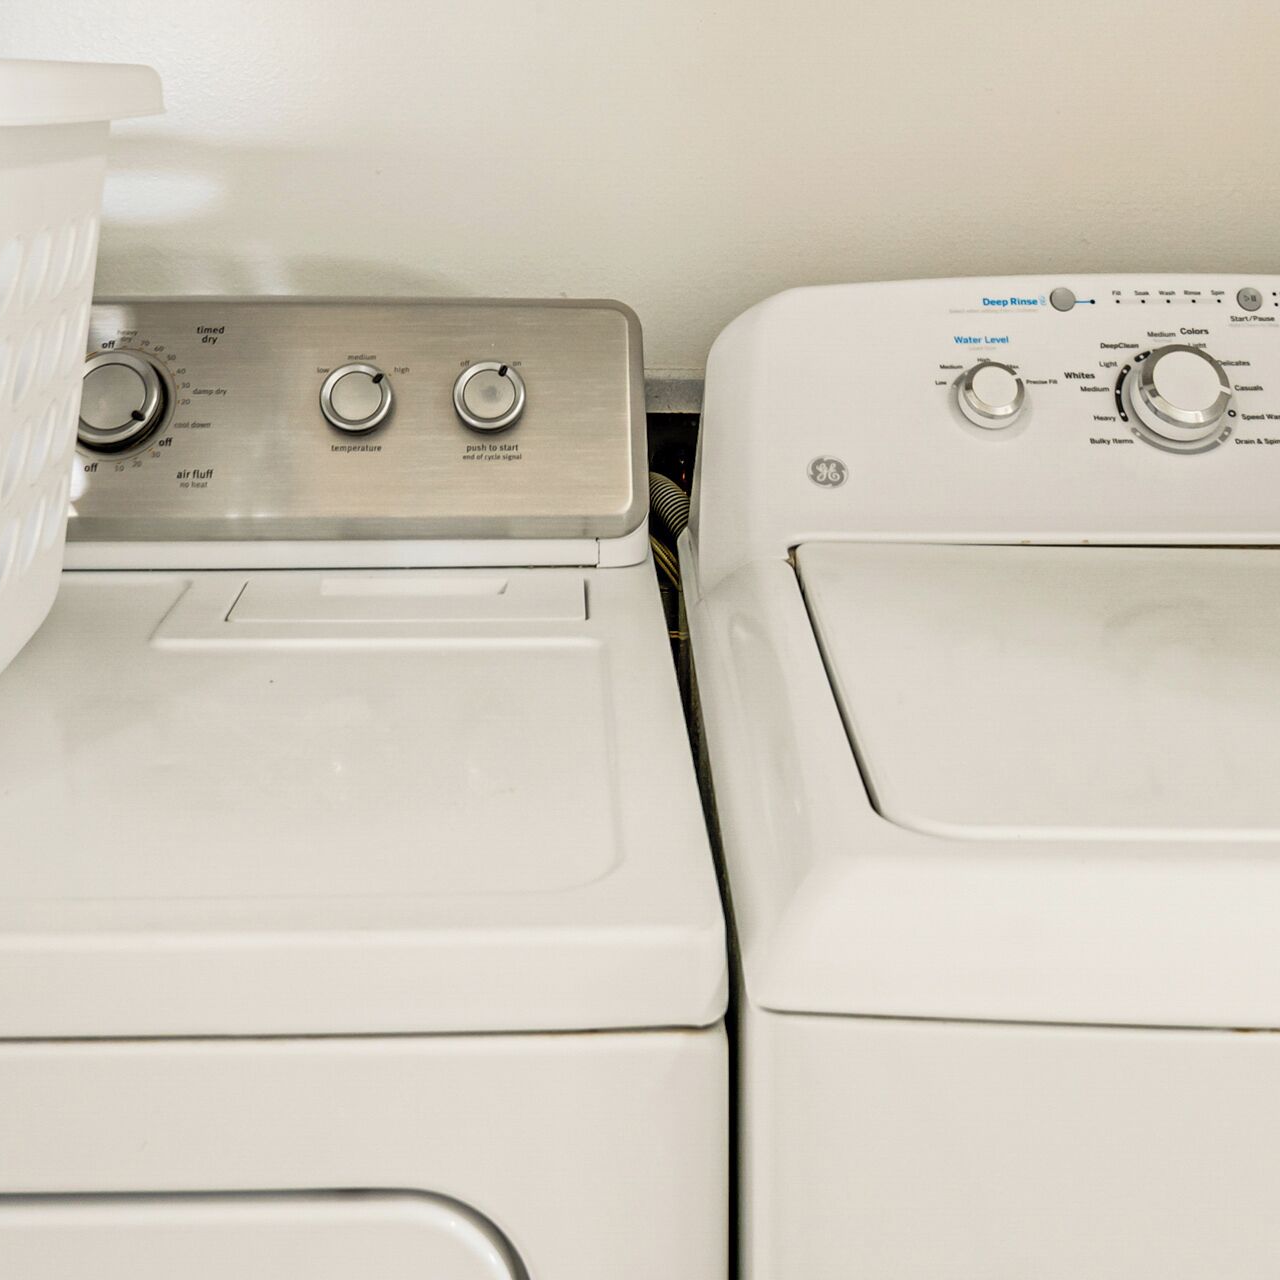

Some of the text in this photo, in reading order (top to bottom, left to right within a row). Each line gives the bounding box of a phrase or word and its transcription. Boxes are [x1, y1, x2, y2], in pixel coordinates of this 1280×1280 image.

[983, 297, 1038, 308] Deep Rinse
[1230, 315, 1275, 323] Start/Pause
[197, 326, 225, 334] timed
[1180, 327, 1209, 335] Colors
[202, 335, 218, 345] dry
[954, 336, 1009, 344] Water Level
[102, 341, 115, 349] off
[1100, 342, 1139, 350] DeepClean
[1099, 361, 1118, 369] Light
[394, 366, 410, 375] high
[1064, 372, 1095, 380] Whites
[193, 388, 227, 396] damp dry
[1235, 384, 1263, 392] Casuals
[1094, 415, 1116, 423] Heavy
[1241, 414, 1265, 422] Speed
[158, 437, 173, 446] off
[1090, 438, 1112, 446] Bulky
[331, 444, 382, 453] temperature
[466, 443, 519, 453] push to start
[484, 453, 501, 461] cycle
[503, 453, 523, 461] signal
[84, 463, 98, 472] off
[176, 469, 214, 479] air fluff
